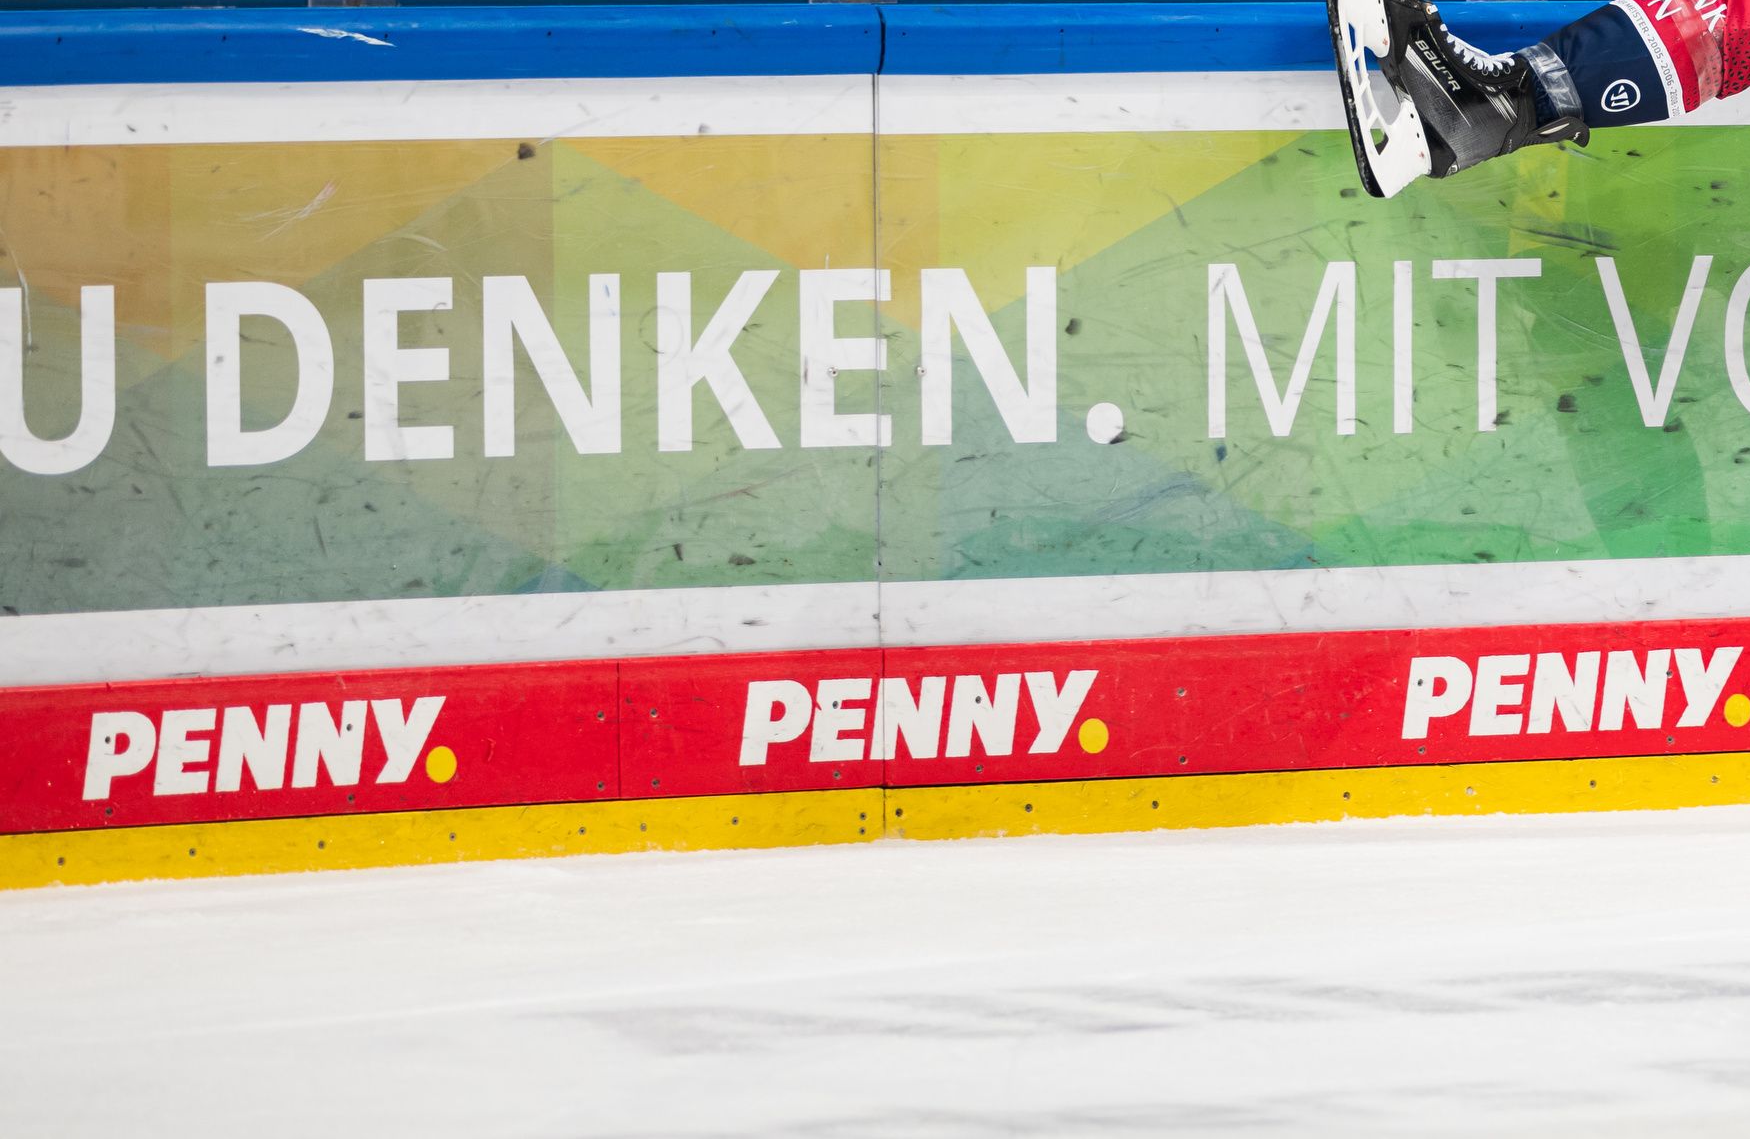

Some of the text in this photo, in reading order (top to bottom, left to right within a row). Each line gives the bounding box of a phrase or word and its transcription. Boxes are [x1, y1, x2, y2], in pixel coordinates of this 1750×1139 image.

[1625, 1, 1648, 37] MEISTER
[1648, 34, 1665, 61] 2005
[1660, 61, 1673, 88] 2006
[204, 263, 1126, 468] DENKEN.
[1207, 258, 1543, 440] MIT
